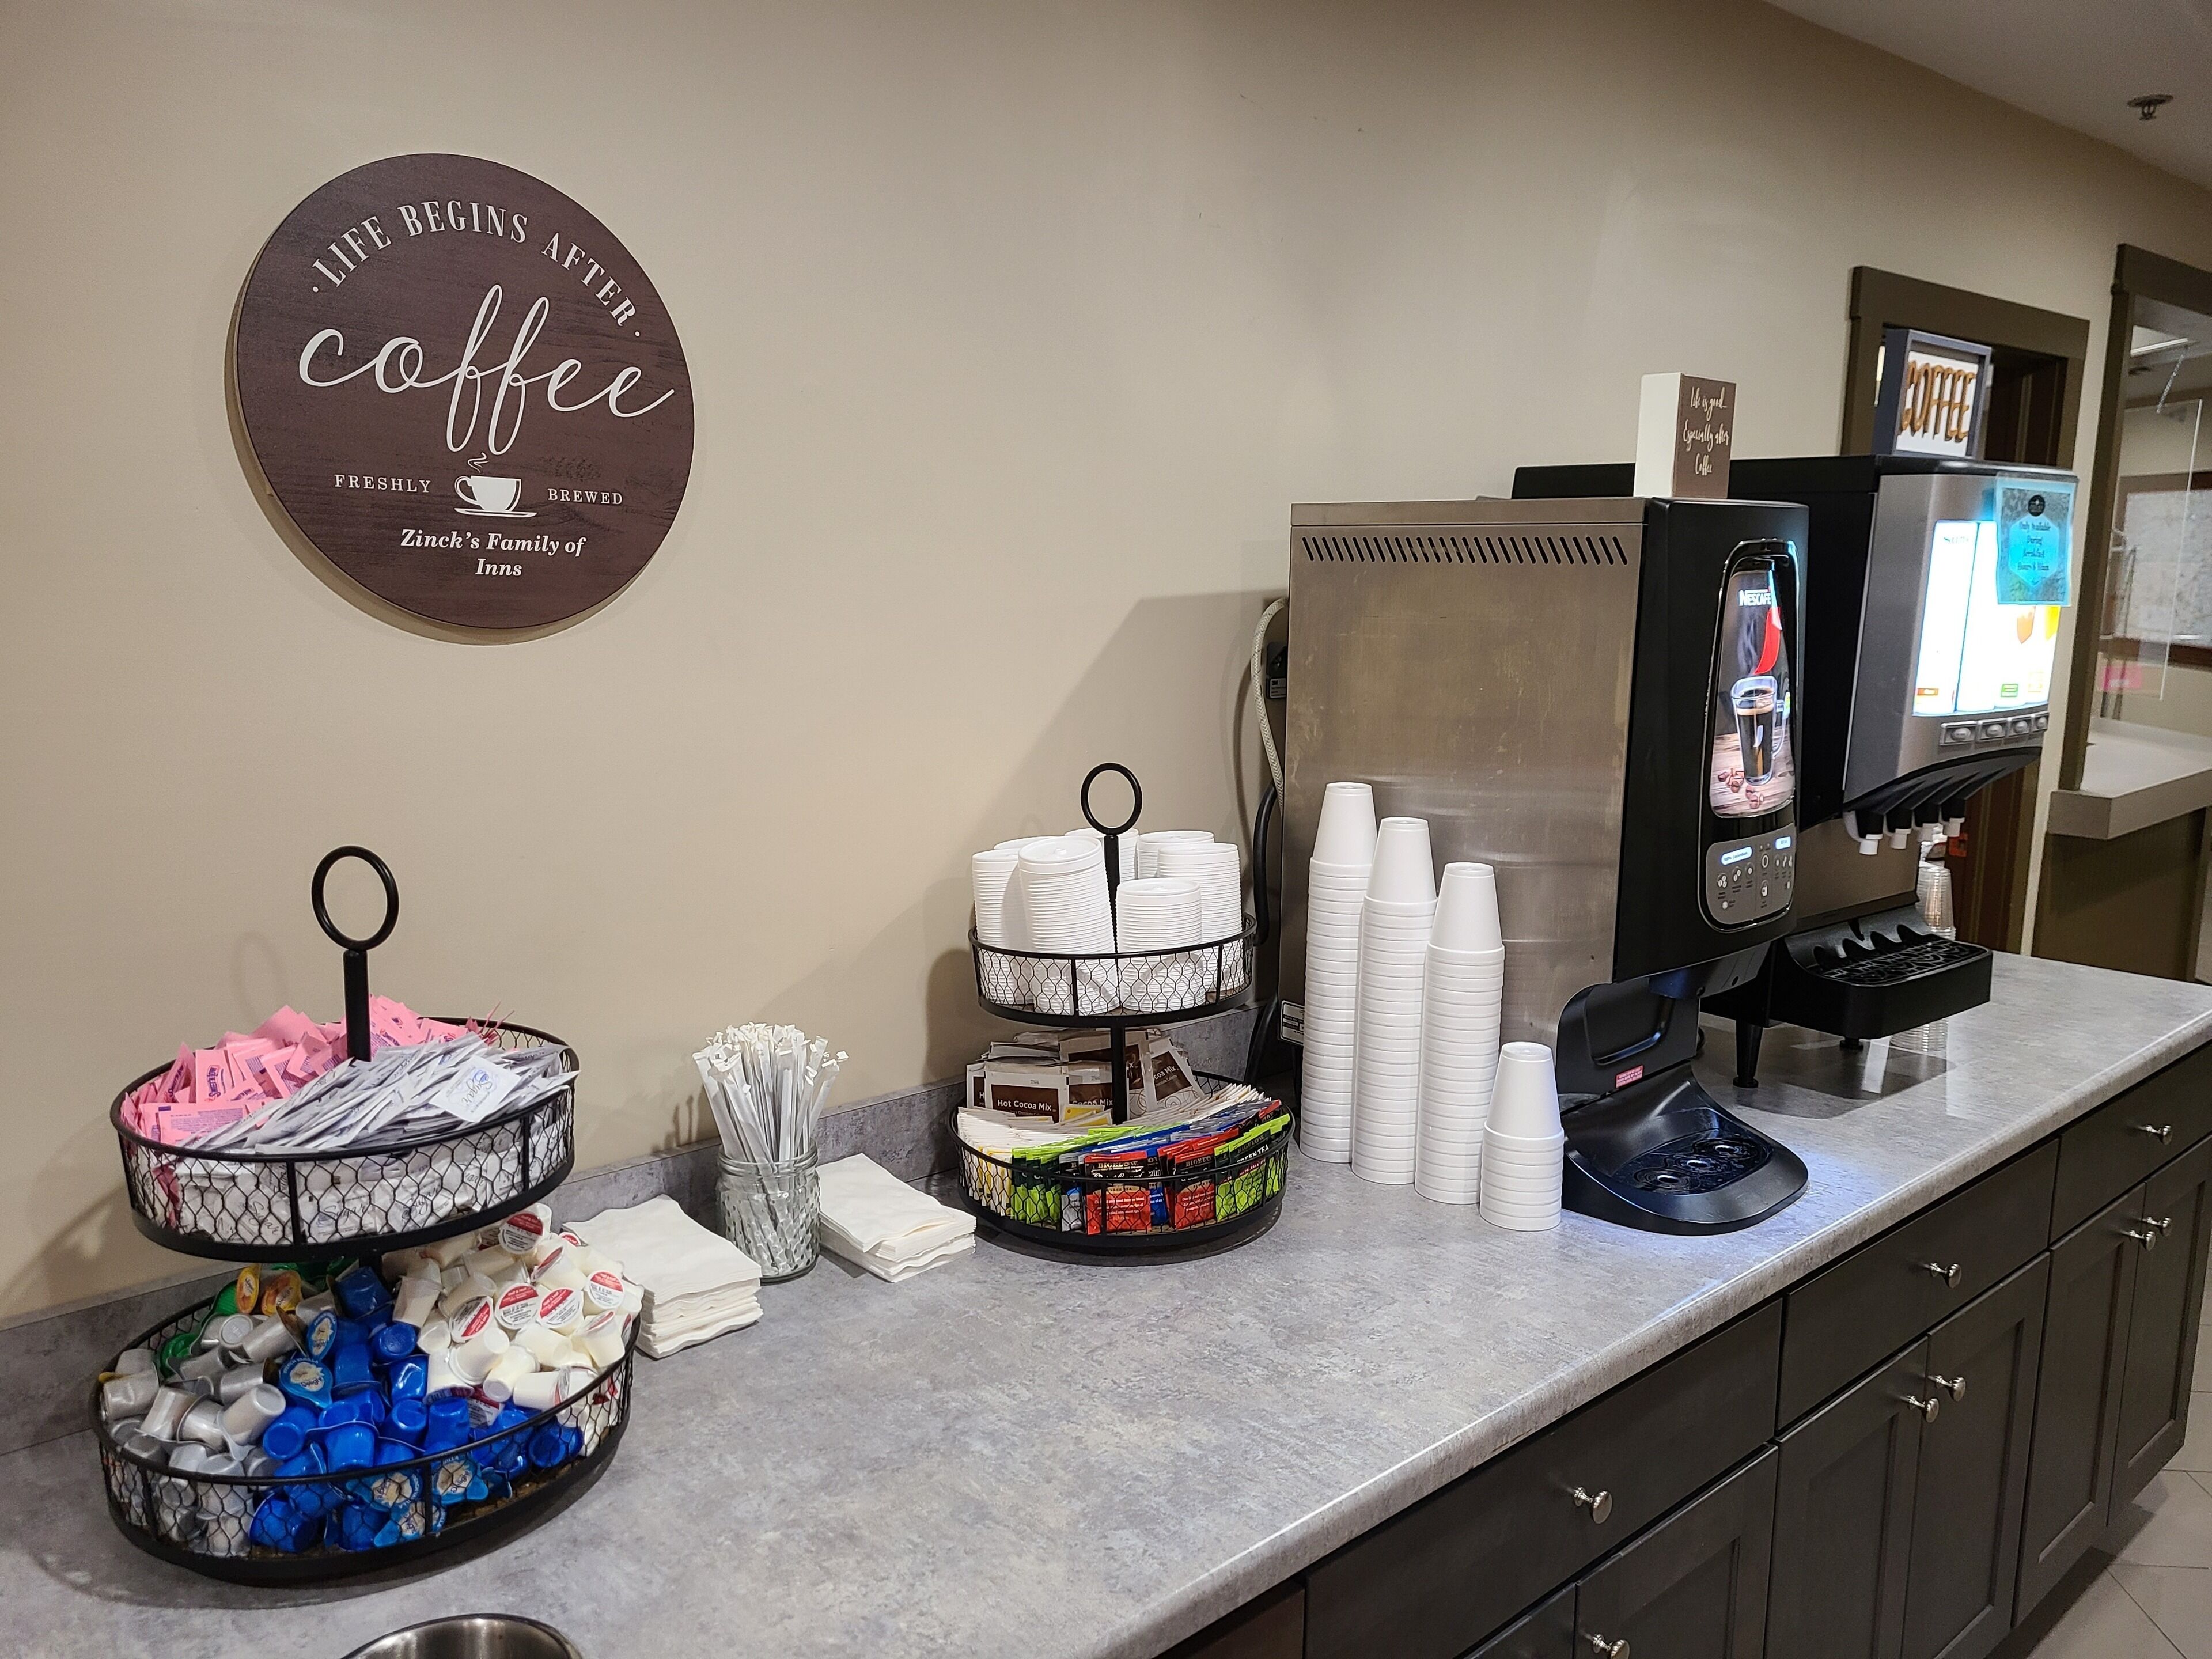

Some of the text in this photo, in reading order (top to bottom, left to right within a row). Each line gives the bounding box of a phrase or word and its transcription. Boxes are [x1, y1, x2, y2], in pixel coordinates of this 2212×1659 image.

[312, 200, 638, 327] LIFE BEGINS AFTER
[298, 284, 675, 455] coffee
[1902, 360, 1977, 442] COFFEE
[334, 474, 623, 505] FRESHLY BREWED
[400, 529, 588, 557] Zinck's Family of
[475, 558, 522, 576] Inns
[1153, 1065, 1177, 1080] coa Mix
[997, 1099, 1052, 1112] Hot Cocoa Mix
[1099, 1097, 1113, 1107] Mix
[1097, 1160, 1139, 1169] BIGELOW
[1185, 1156, 1212, 1167] BIGELO
[323, 1203, 366, 1225] Sugar
